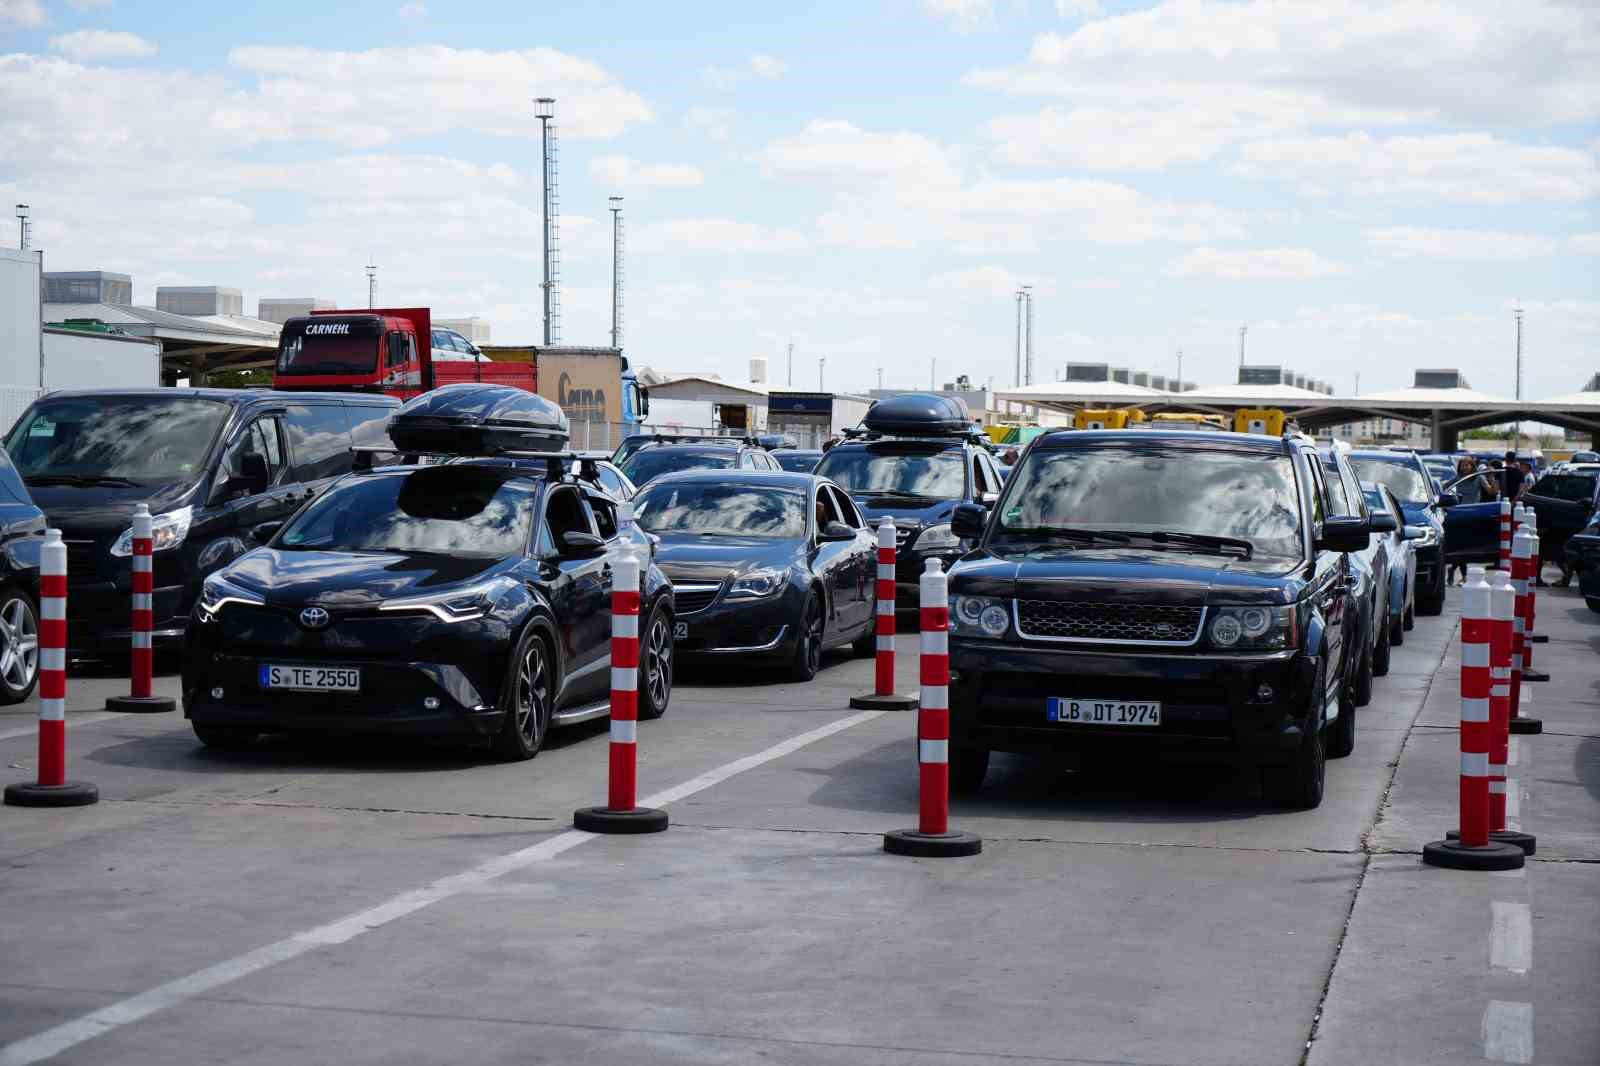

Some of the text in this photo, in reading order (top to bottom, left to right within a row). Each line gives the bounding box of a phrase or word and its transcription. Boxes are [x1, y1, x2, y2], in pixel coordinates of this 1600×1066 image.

[305, 323, 350, 335] CARNEHL
[270, 668, 358, 687] S TE 2550
[1059, 701, 1159, 723] LB DT 1974
